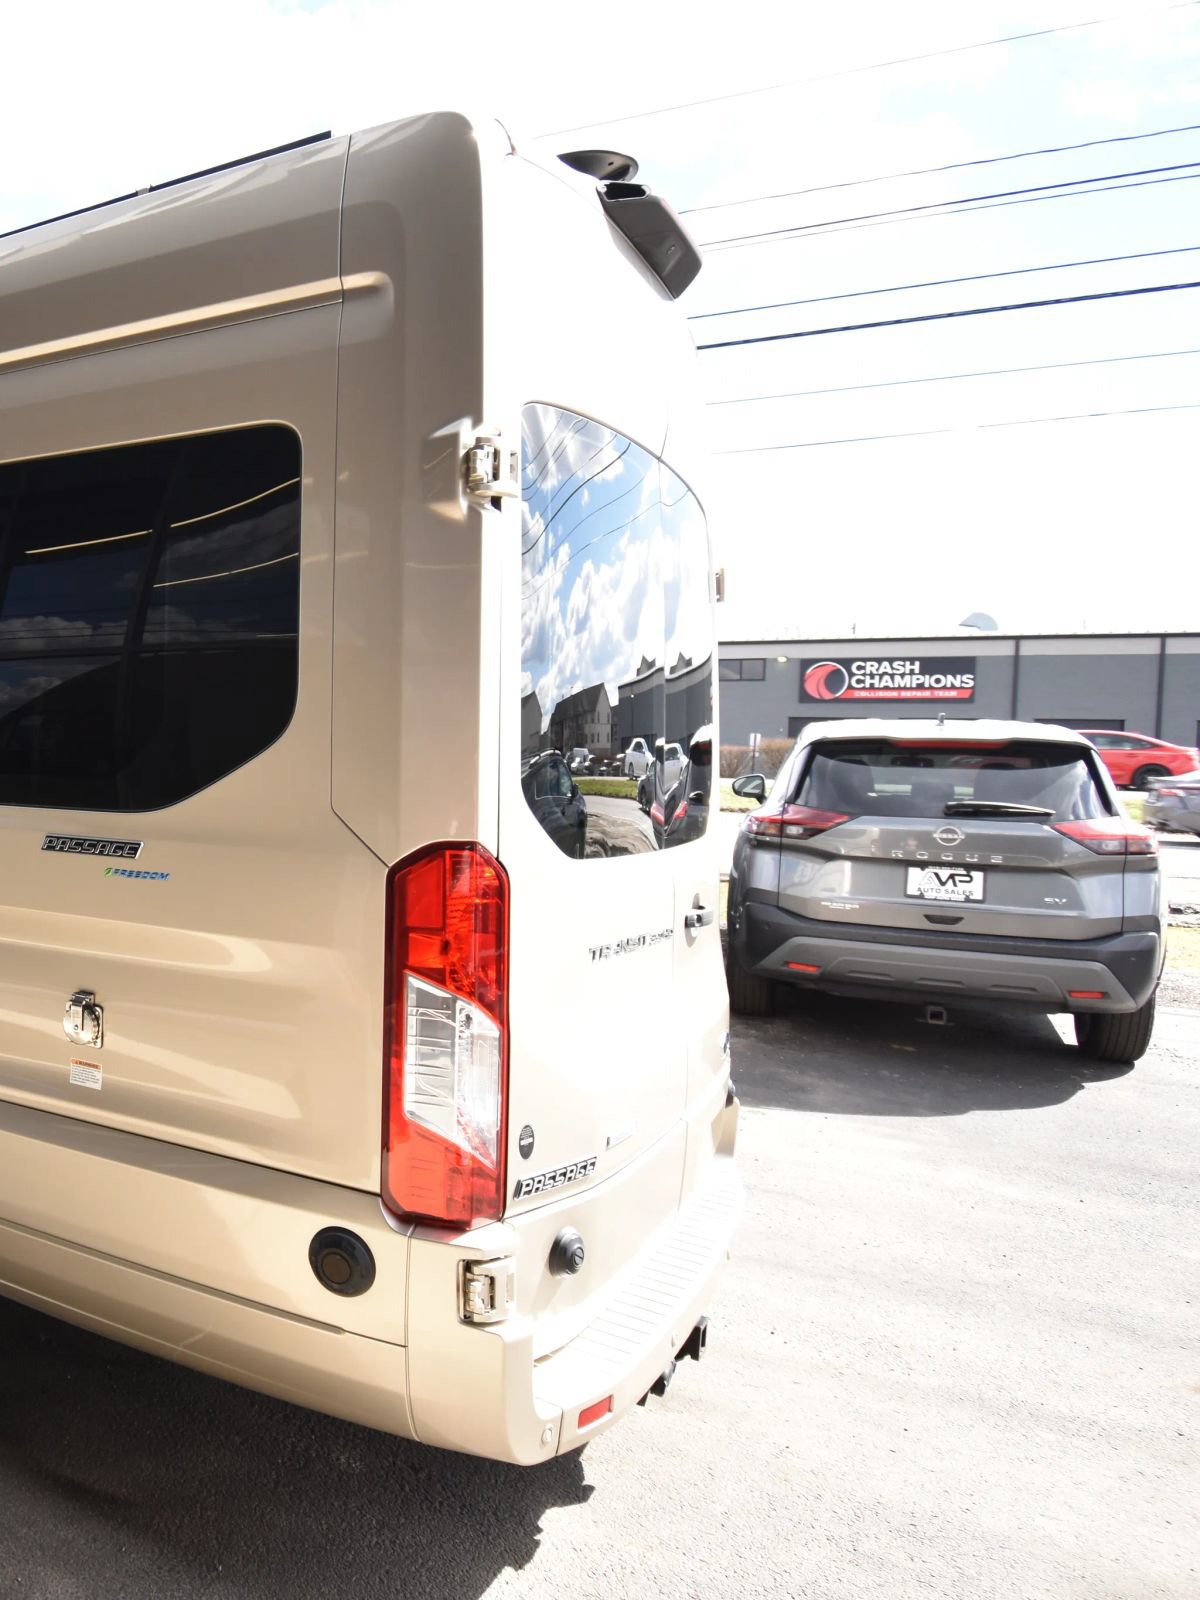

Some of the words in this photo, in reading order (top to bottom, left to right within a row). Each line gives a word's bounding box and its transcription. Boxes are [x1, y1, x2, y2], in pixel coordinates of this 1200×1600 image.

[851, 661, 920, 675] CRASH
[850, 674, 975, 689] CHAMPIONS
[42, 836, 140, 858] PASSAGE
[891, 850, 1003, 863] ROGUE
[112, 867, 170, 881] FREEDOM
[916, 887, 941, 895] AUTO
[944, 888, 974, 897] SALES
[519, 1158, 597, 1199] PASSAGE
